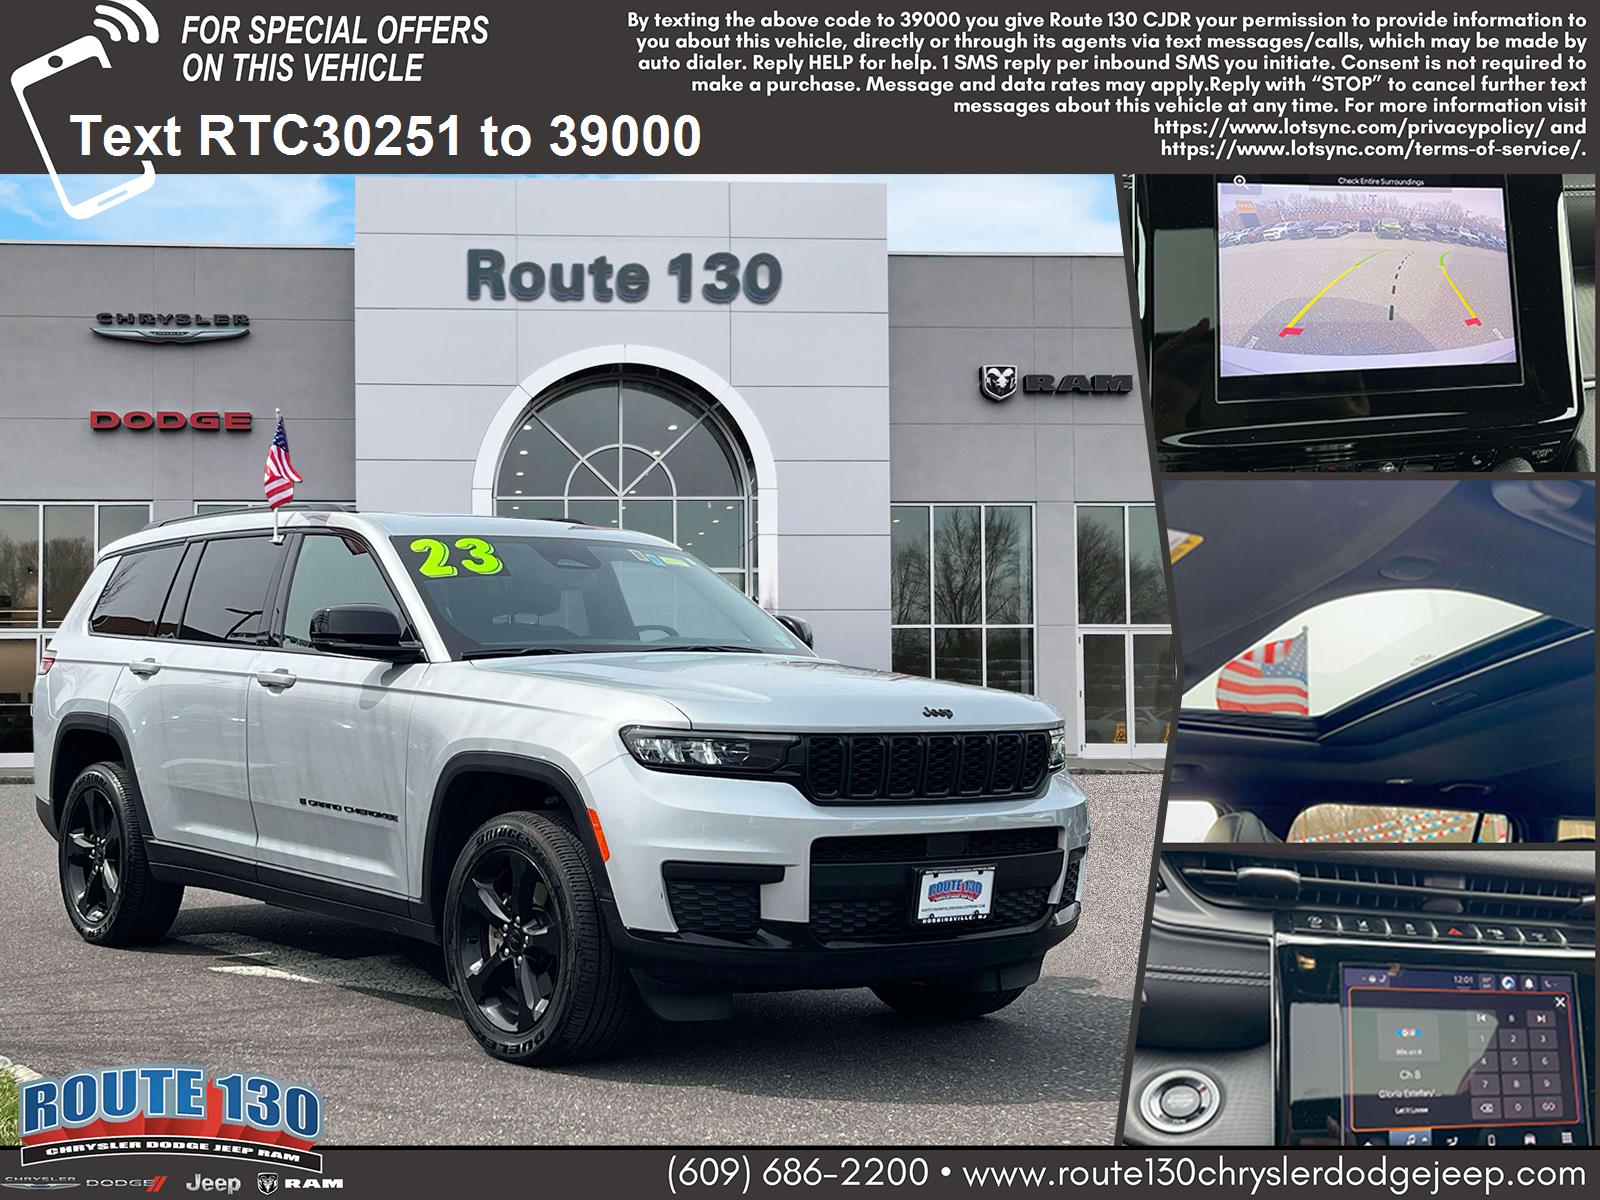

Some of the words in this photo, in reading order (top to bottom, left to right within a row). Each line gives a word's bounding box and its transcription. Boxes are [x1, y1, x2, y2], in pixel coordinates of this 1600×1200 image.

[1337, 176, 1360, 185] Check
[1360, 177, 1380, 185] Entire
[1380, 177, 1425, 187] Surroundings
[467, 248, 650, 303] Route
[667, 251, 782, 305] 130
[96, 312, 250, 326] CHRYSLER
[1022, 374, 1134, 395] RAM
[90, 410, 252, 431] DODGE
[409, 537, 505, 579] 23
[922, 706, 954, 720] Jeep
[308, 800, 342, 811] GRAND
[344, 806, 399, 823] CHEROKEE
[928, 879, 963, 897] ROUTE
[1453, 975, 1474, 985] 12:01
[1399, 1069, 1414, 1080] Ch
[1378, 1089, 1403, 1099] Gloria
